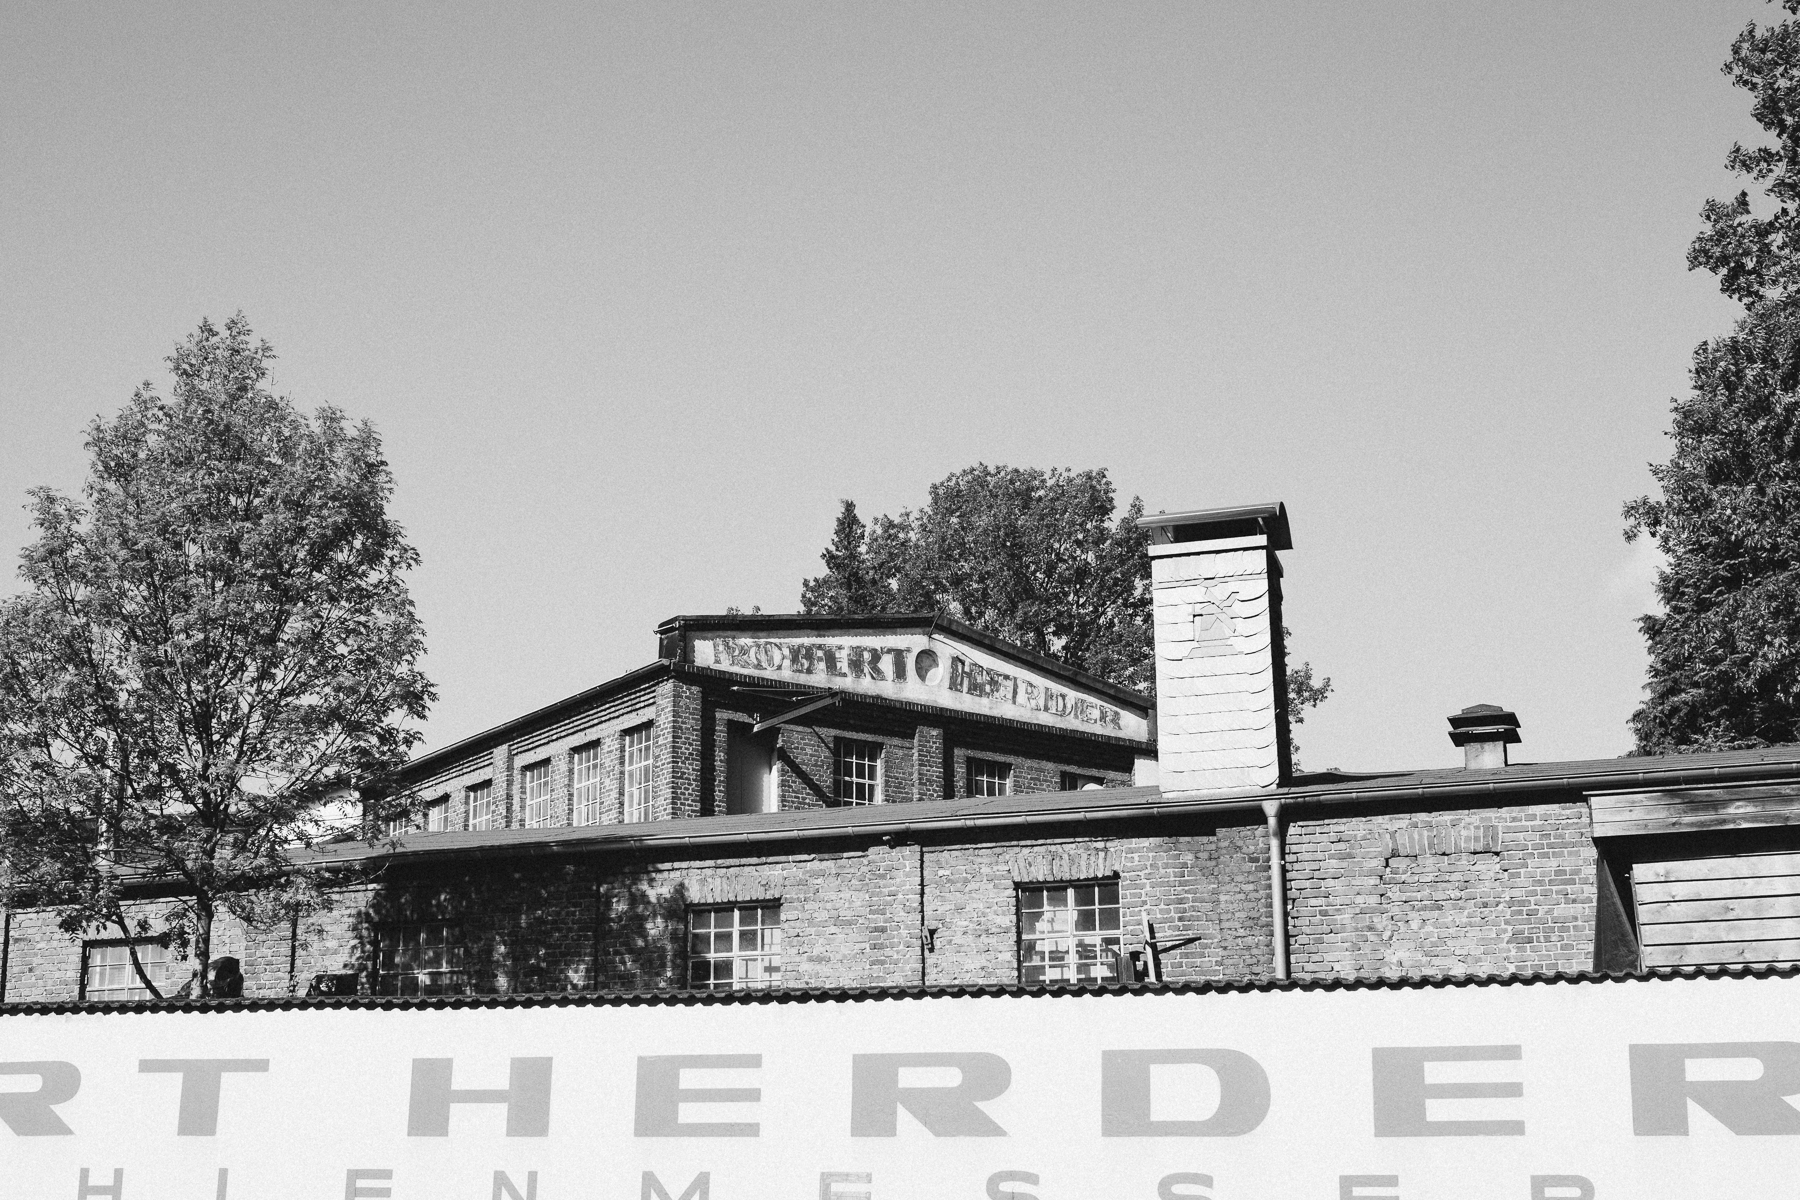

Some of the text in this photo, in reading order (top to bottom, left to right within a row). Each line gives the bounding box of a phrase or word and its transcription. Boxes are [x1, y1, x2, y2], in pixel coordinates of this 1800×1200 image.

[713, 638, 1122, 730] ROBERT HERDER
[0, 1040, 1800, 1137] RT HERDER
